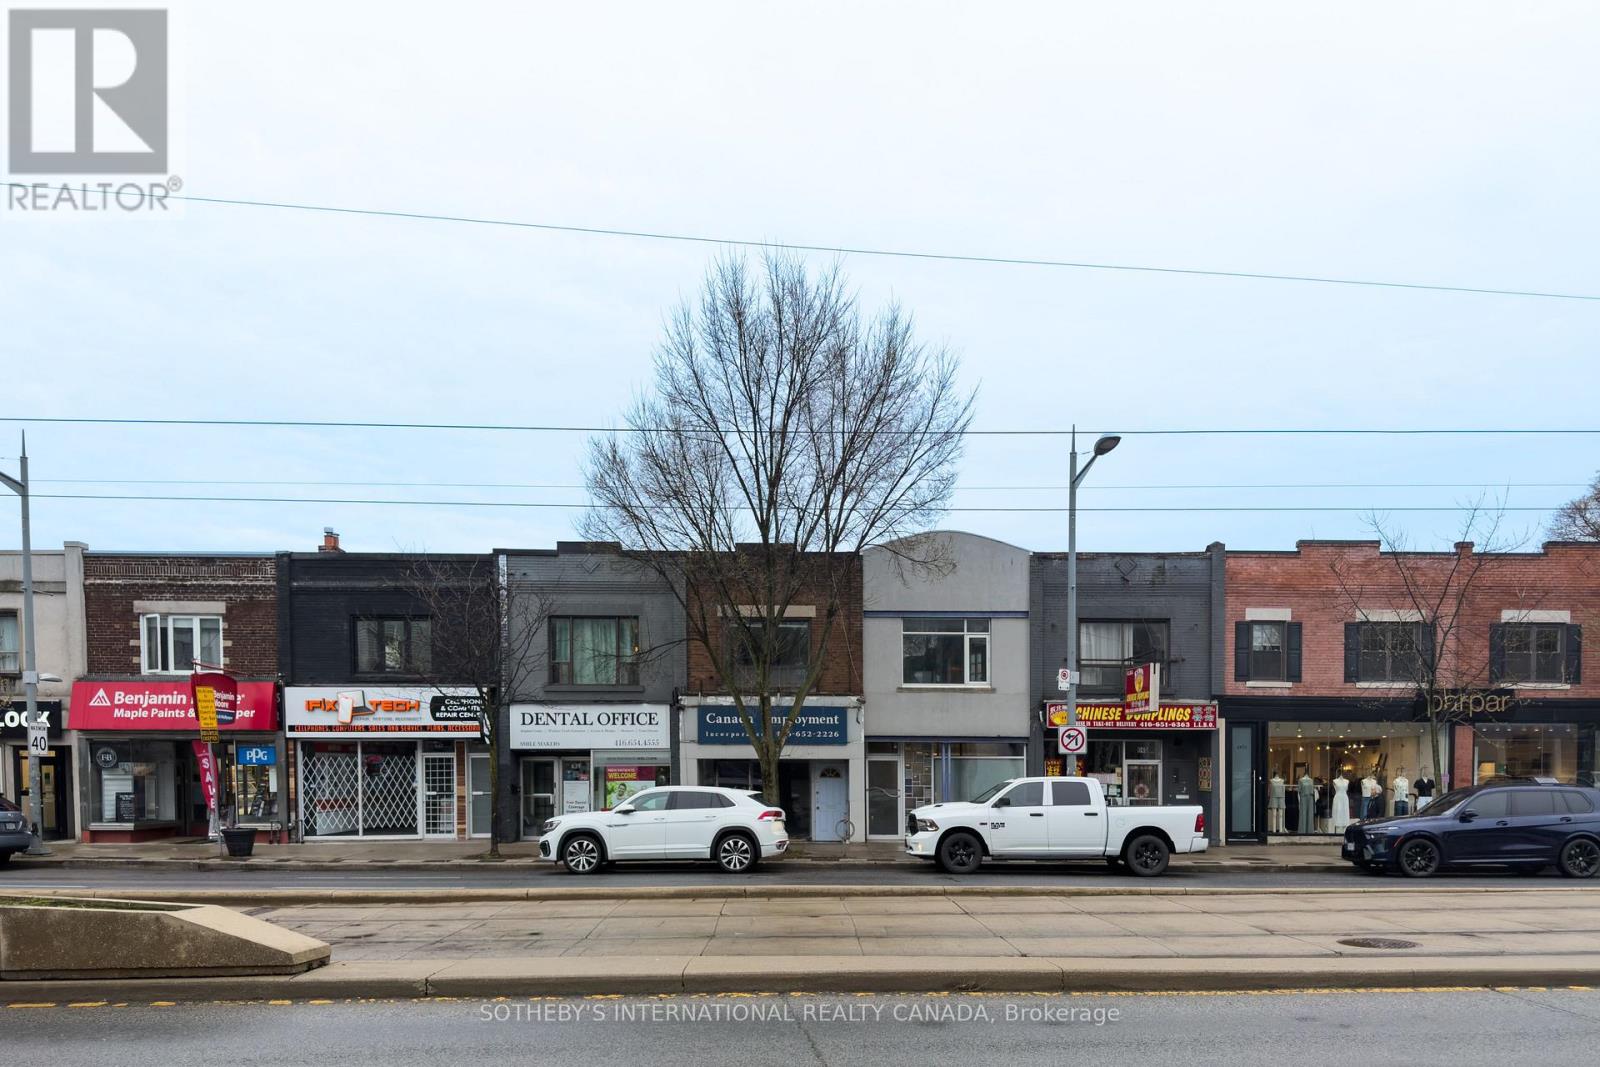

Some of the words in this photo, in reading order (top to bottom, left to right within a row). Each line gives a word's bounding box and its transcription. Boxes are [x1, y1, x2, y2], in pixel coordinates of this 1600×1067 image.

[114, 691, 186, 705] Benjamin
[215, 700, 229, 708] oore
[368, 699, 420, 712] TECH
[114, 708, 148, 719] Maple
[151, 708, 184, 718] Paints
[187, 709, 195, 718] &
[520, 712, 594, 726] DENTAL
[597, 712, 659, 726] OFFICE
[1076, 706, 1123, 720] CHINESE
[771, 715, 839, 727] mpoyment
[776, 730, 840, 738] 46-652-2226
[32, 735, 47, 751] 40
[246, 748, 268, 763] PPG
[201, 758, 217, 809] SALE
